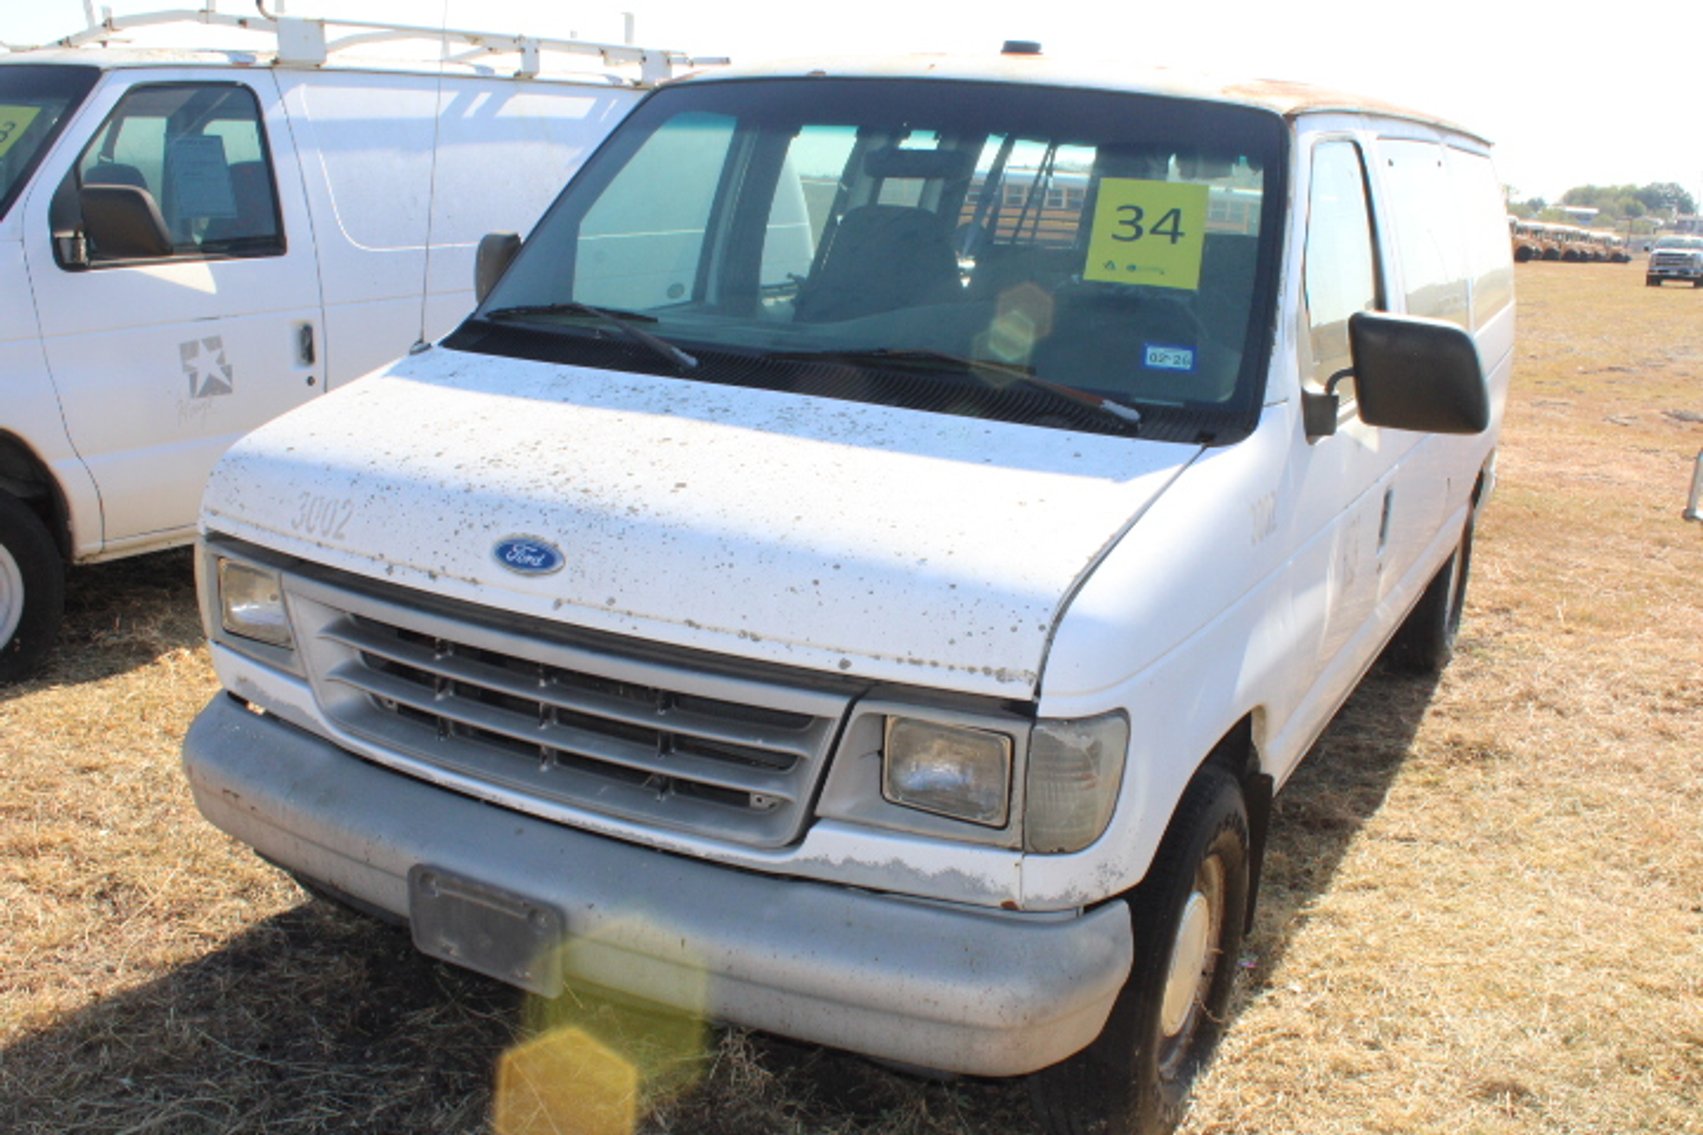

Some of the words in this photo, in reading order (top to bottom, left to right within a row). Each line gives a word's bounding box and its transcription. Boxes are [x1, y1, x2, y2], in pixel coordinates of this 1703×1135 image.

[1111, 204, 1186, 245] 34
[290, 490, 355, 541] 3002
[506, 543, 546, 567] Ford
